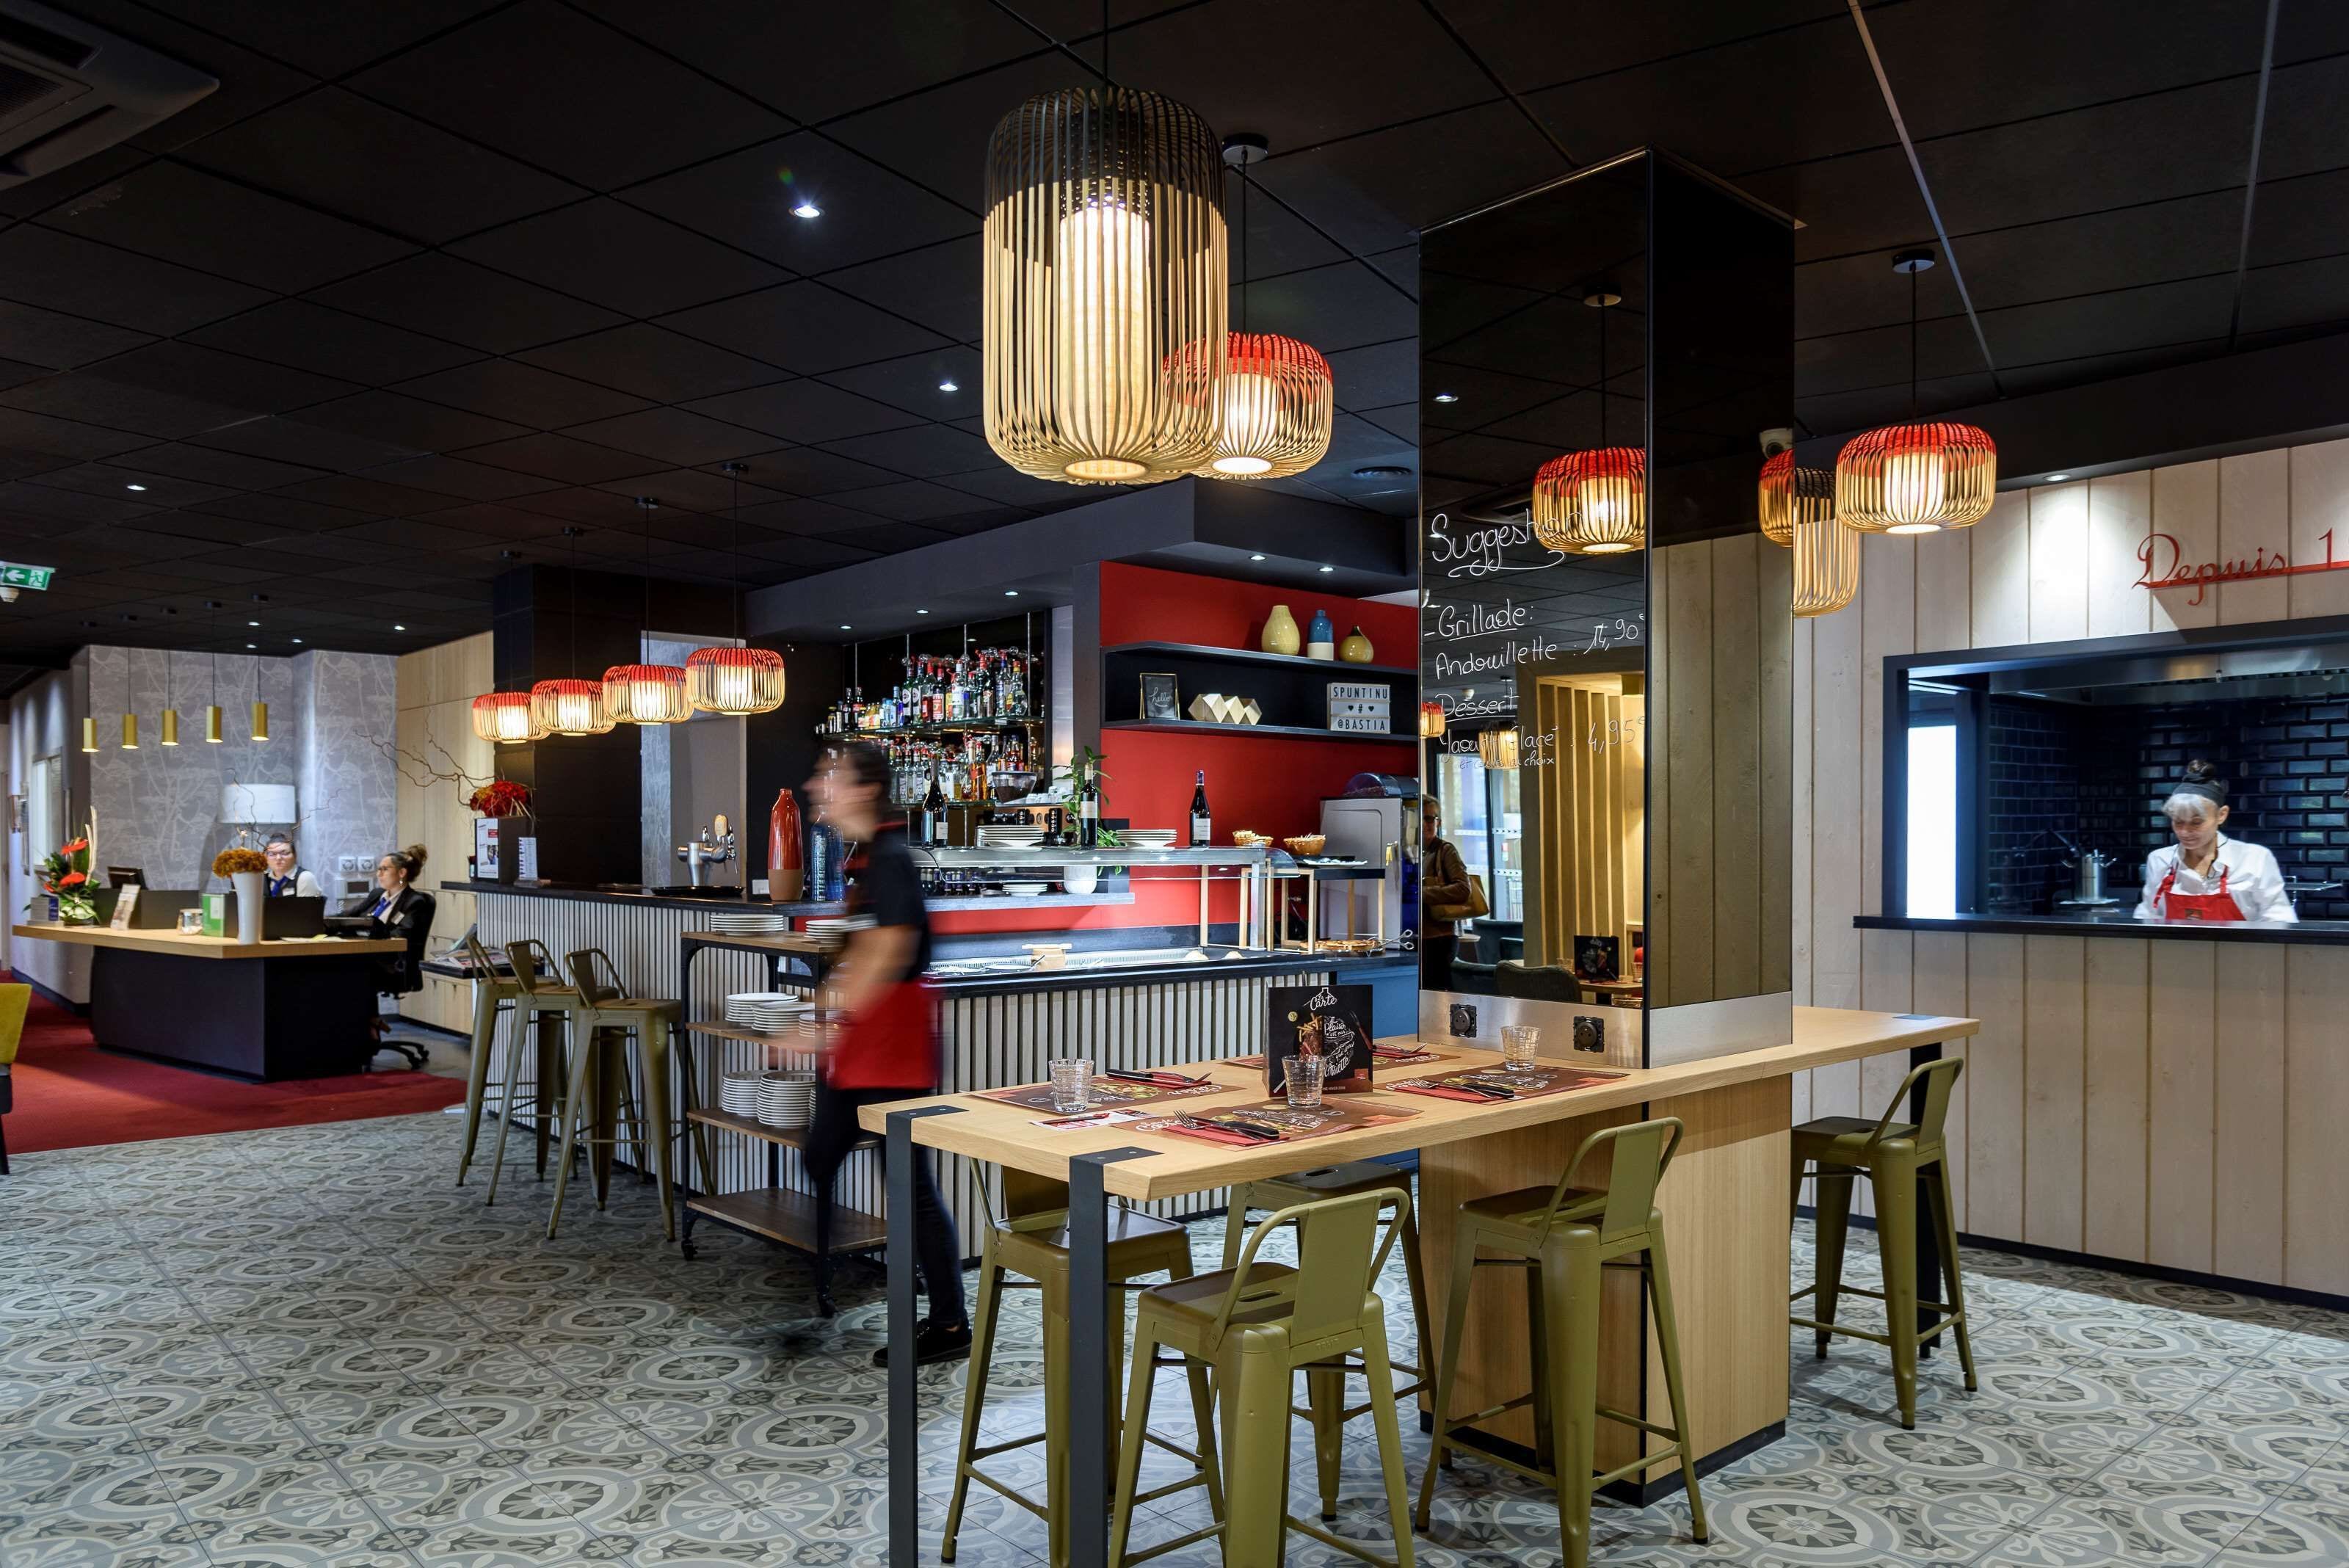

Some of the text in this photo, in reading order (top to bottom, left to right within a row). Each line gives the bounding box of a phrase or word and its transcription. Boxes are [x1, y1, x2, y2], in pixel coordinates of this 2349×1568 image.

[2132, 534, 2286, 606] Depuis
[1437, 636, 1557, 680] Andouillette
[1148, 686, 1172, 705] hello
[1333, 686, 1387, 699] SPUNTINU
[1435, 687, 1520, 717] Dessert
[1337, 719, 1385, 730] @BASTIA
[1525, 750, 1555, 766] choix
[1310, 994, 1337, 1010] Carte
